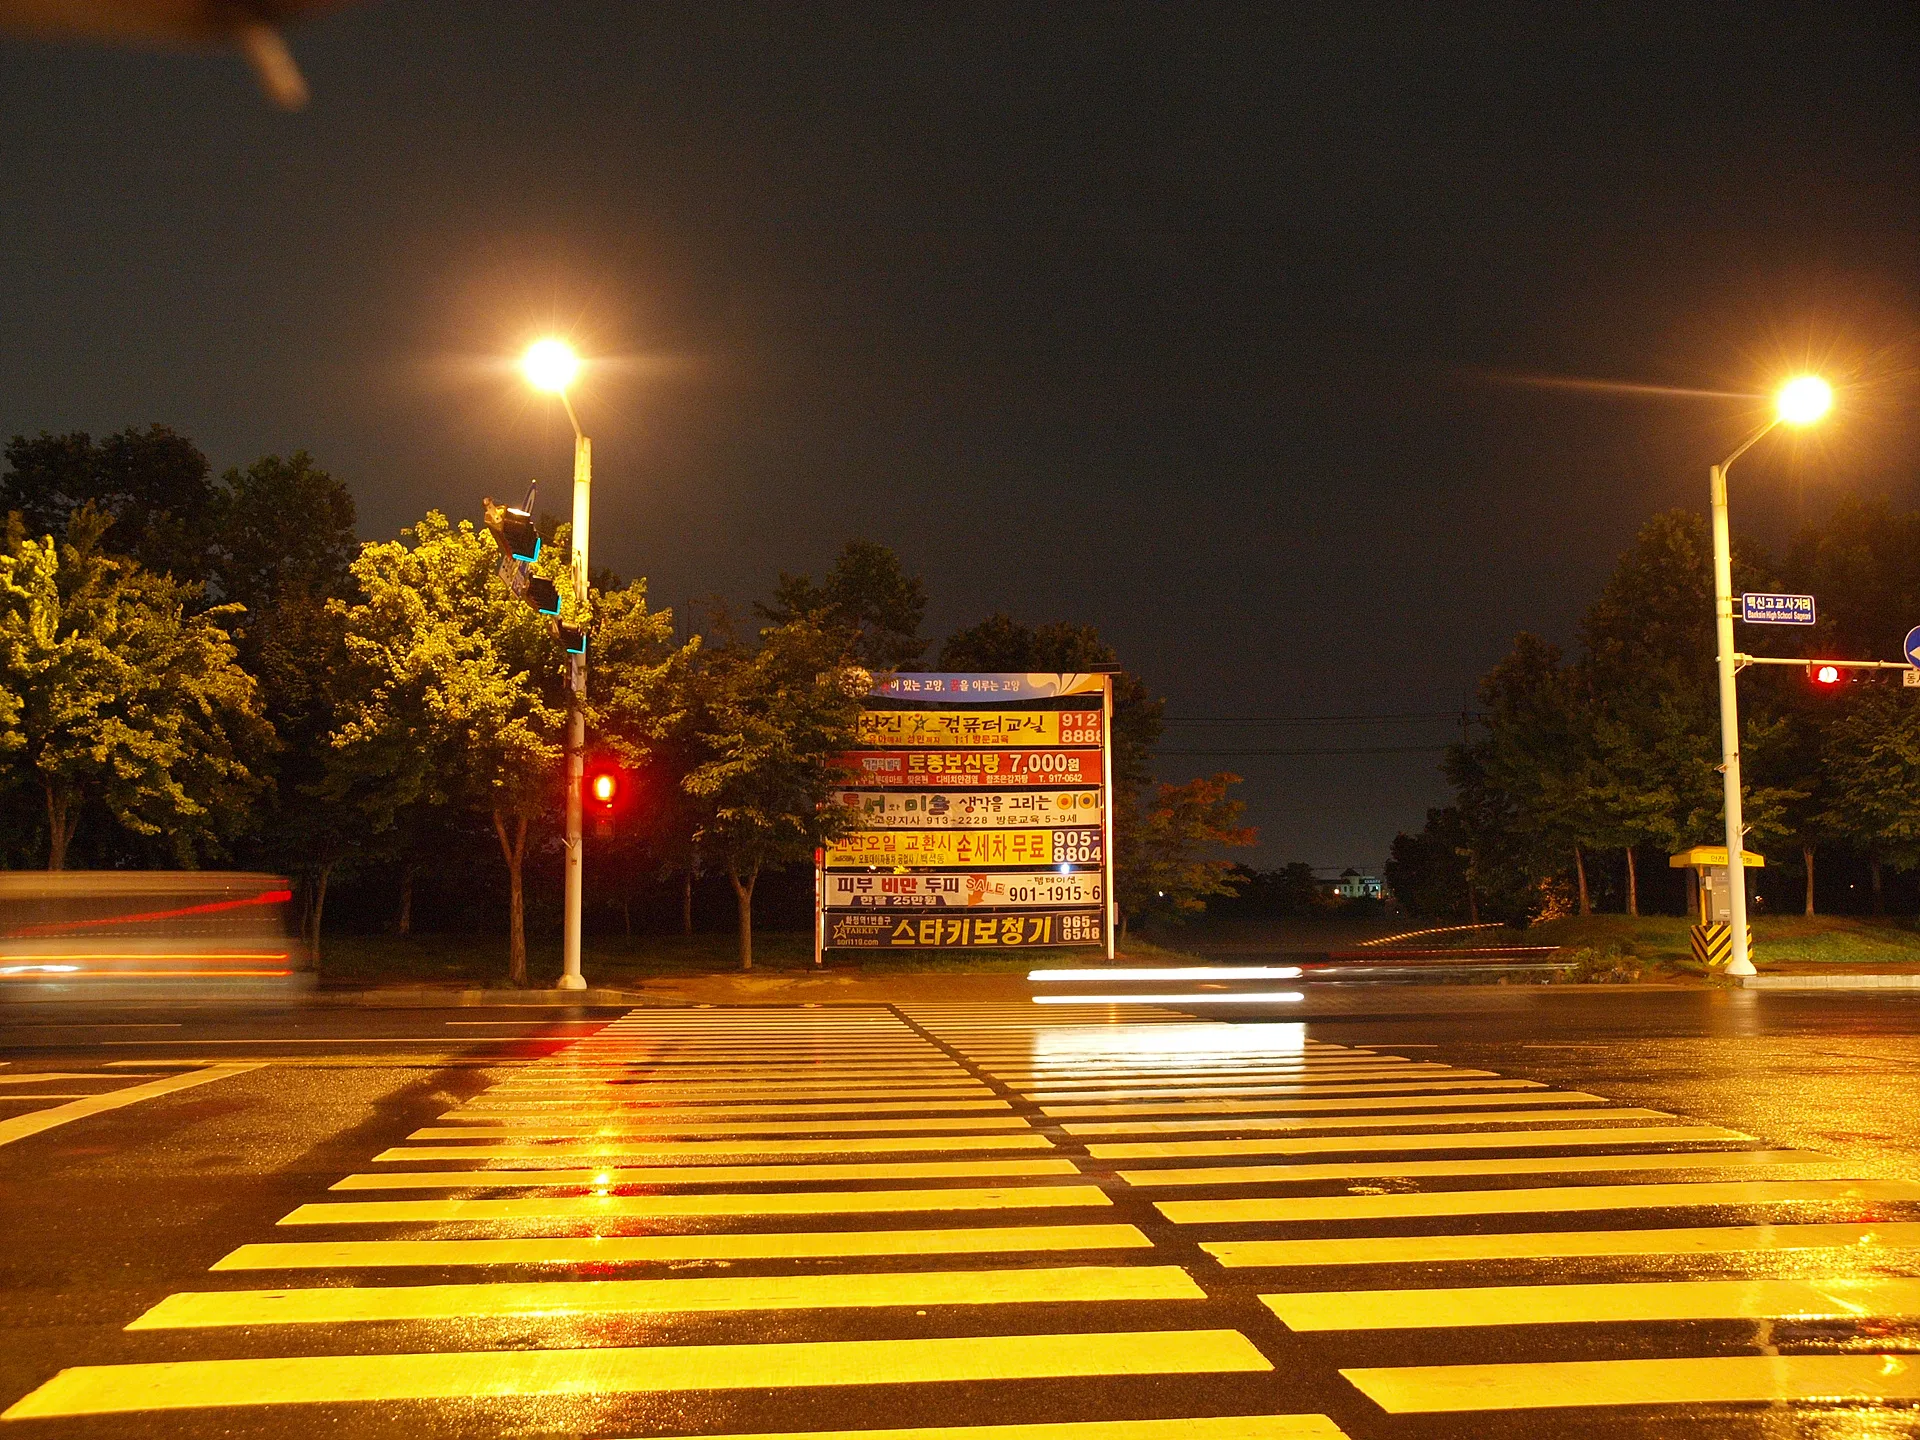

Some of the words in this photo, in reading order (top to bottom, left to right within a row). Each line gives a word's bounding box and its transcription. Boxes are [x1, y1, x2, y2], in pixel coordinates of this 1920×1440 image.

[903, 680, 921, 691] 있는
[972, 680, 999, 692] 이루는
[1002, 680, 1020, 692] 고양
[954, 735, 969, 744] 1:1
[972, 734, 1009, 744] 방문교육
[908, 754, 999, 774] 토종보신탕
[1009, 753, 1080, 773] 7,000원
[1049, 774, 1082, 783] 917-0642
[904, 795, 950, 815] 미술
[959, 795, 1003, 813] 생각을
[1008, 795, 1052, 811] 그리는
[1056, 792, 1099, 810] 아이
[926, 816, 988, 825] 913-2228
[996, 815, 1040, 825] 방문교육
[1053, 831, 1100, 847] 905-
[905, 834, 951, 852] 교환시
[957, 834, 1007, 862] 손세차
[1012, 834, 1044, 862] 무료
[1053, 847, 1101, 862] 8804
[920, 854, 944, 865] 백석동
[837, 877, 873, 893] 피부
[881, 877, 918, 893] 비만
[925, 877, 959, 893] 두피
[965, 878, 1006, 896] SALE
[860, 895, 888, 905] 한달
[893, 895, 937, 905] 25만원
[1063, 915, 1100, 928] 965-
[840, 927, 880, 935] STARKEY
[891, 916, 1052, 946] 스타키보청기
[1063, 927, 1100, 940] 6548
